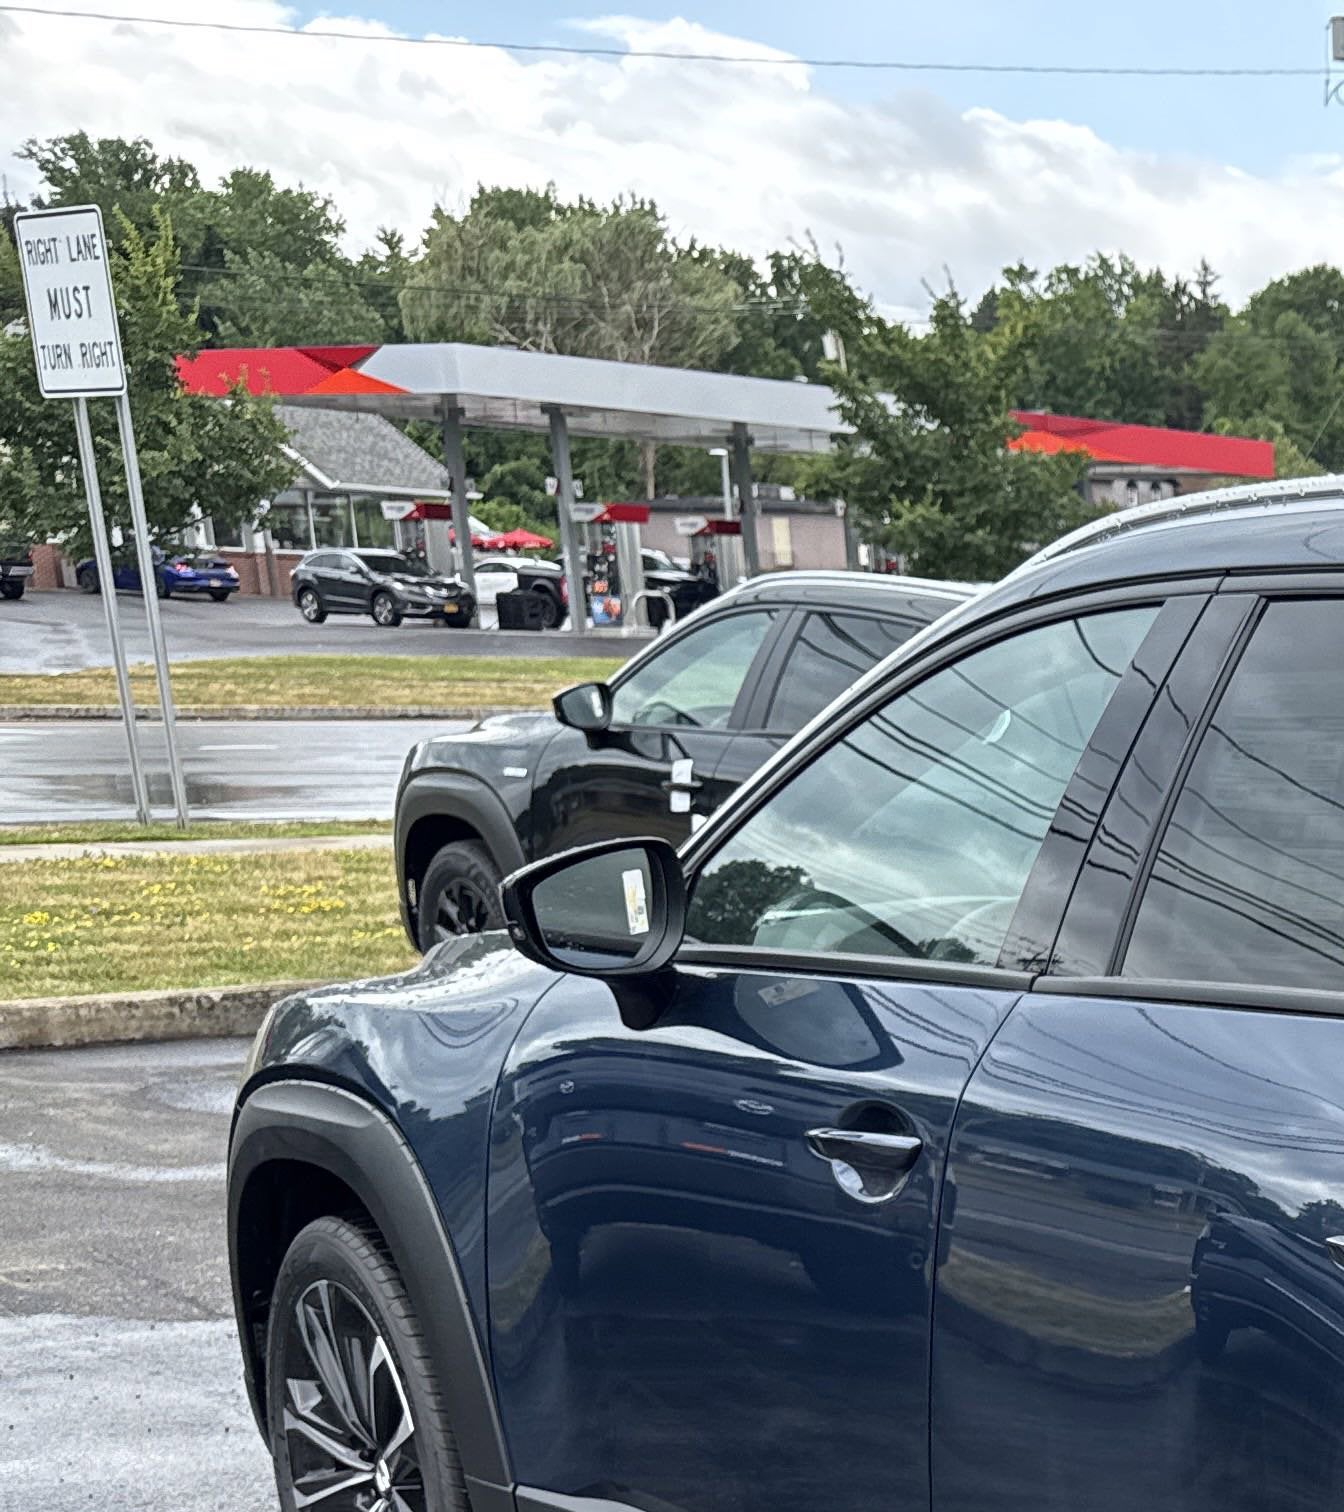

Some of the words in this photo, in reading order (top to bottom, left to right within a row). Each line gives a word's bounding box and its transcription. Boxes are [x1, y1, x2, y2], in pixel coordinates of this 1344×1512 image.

[25, 237, 60, 265] RIGHT
[67, 234, 100, 262] LANE
[47, 286, 92, 320] MUST
[40, 343, 73, 370] TURN
[80, 341, 115, 368] RIGHT
